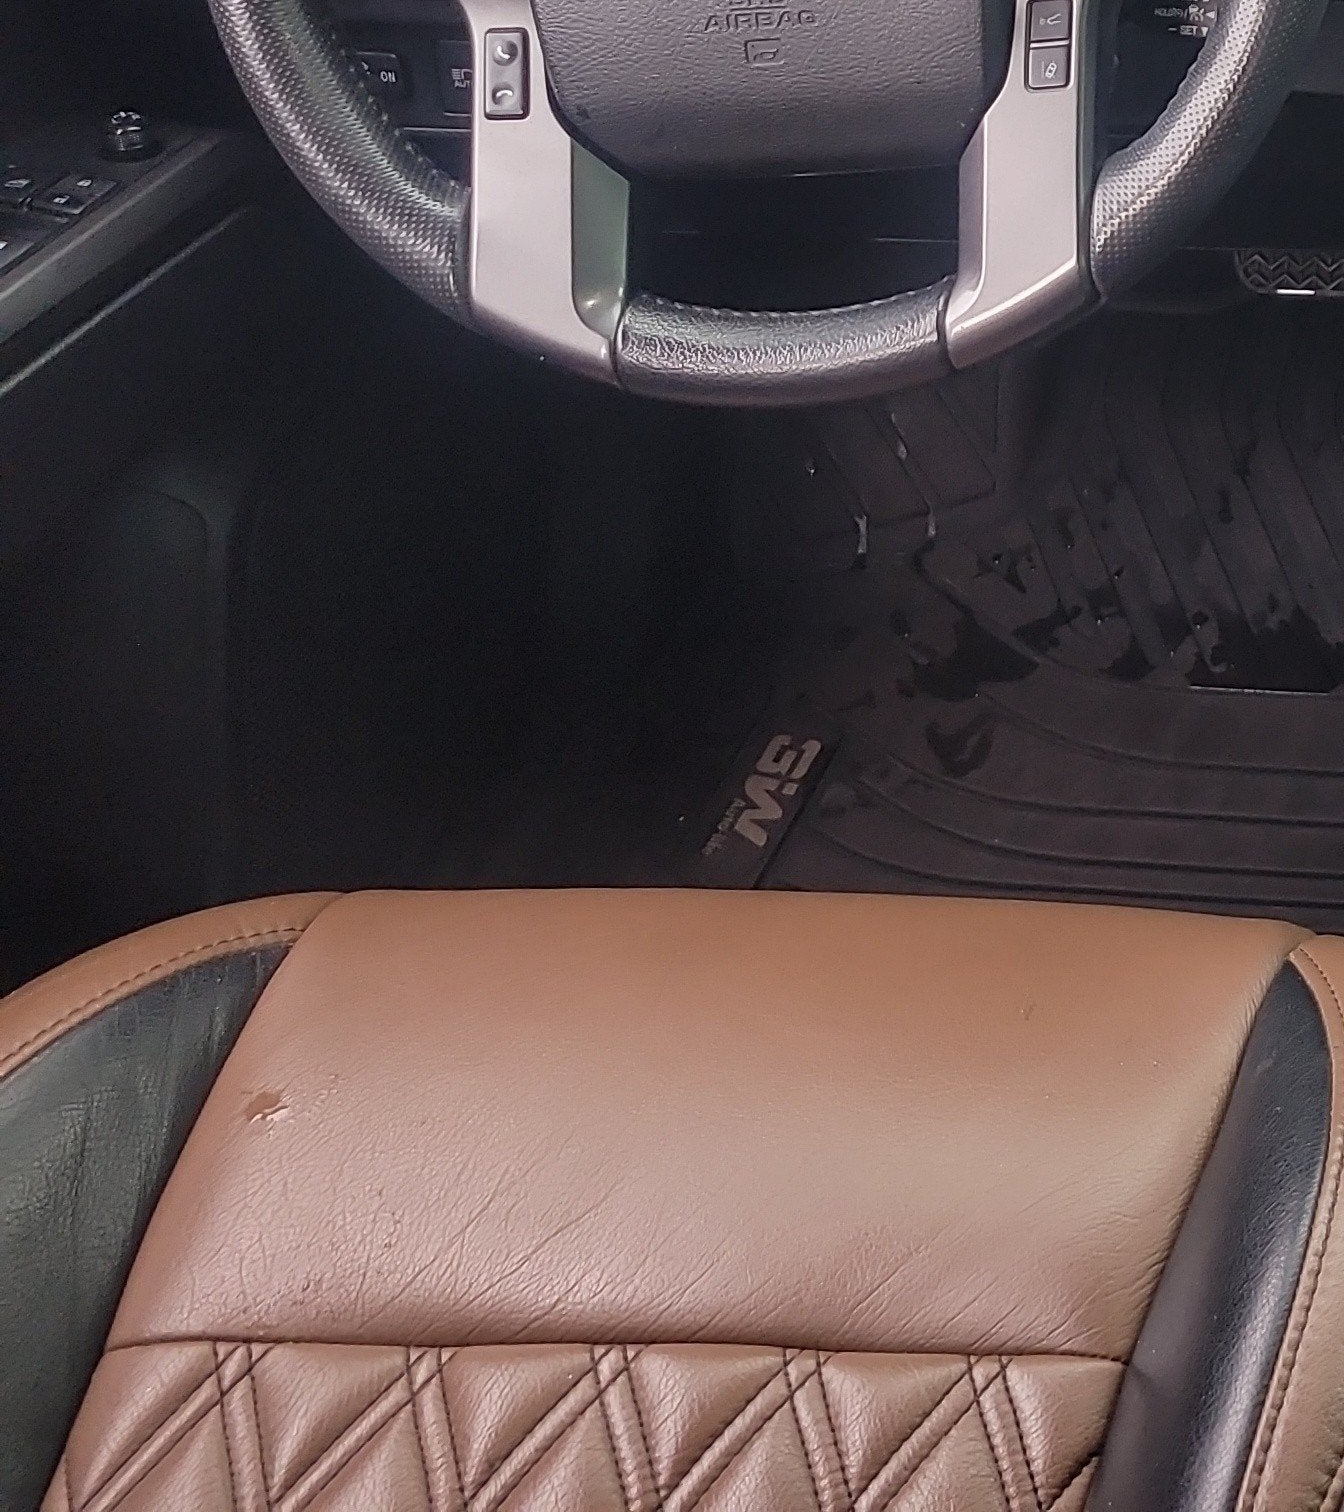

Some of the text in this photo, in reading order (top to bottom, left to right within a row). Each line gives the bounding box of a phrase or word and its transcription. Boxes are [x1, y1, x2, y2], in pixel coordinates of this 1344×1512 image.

[703, 9, 817, 32] AIRBAG
[380, 70, 397, 83] ON
[454, 79, 474, 89] AUT
